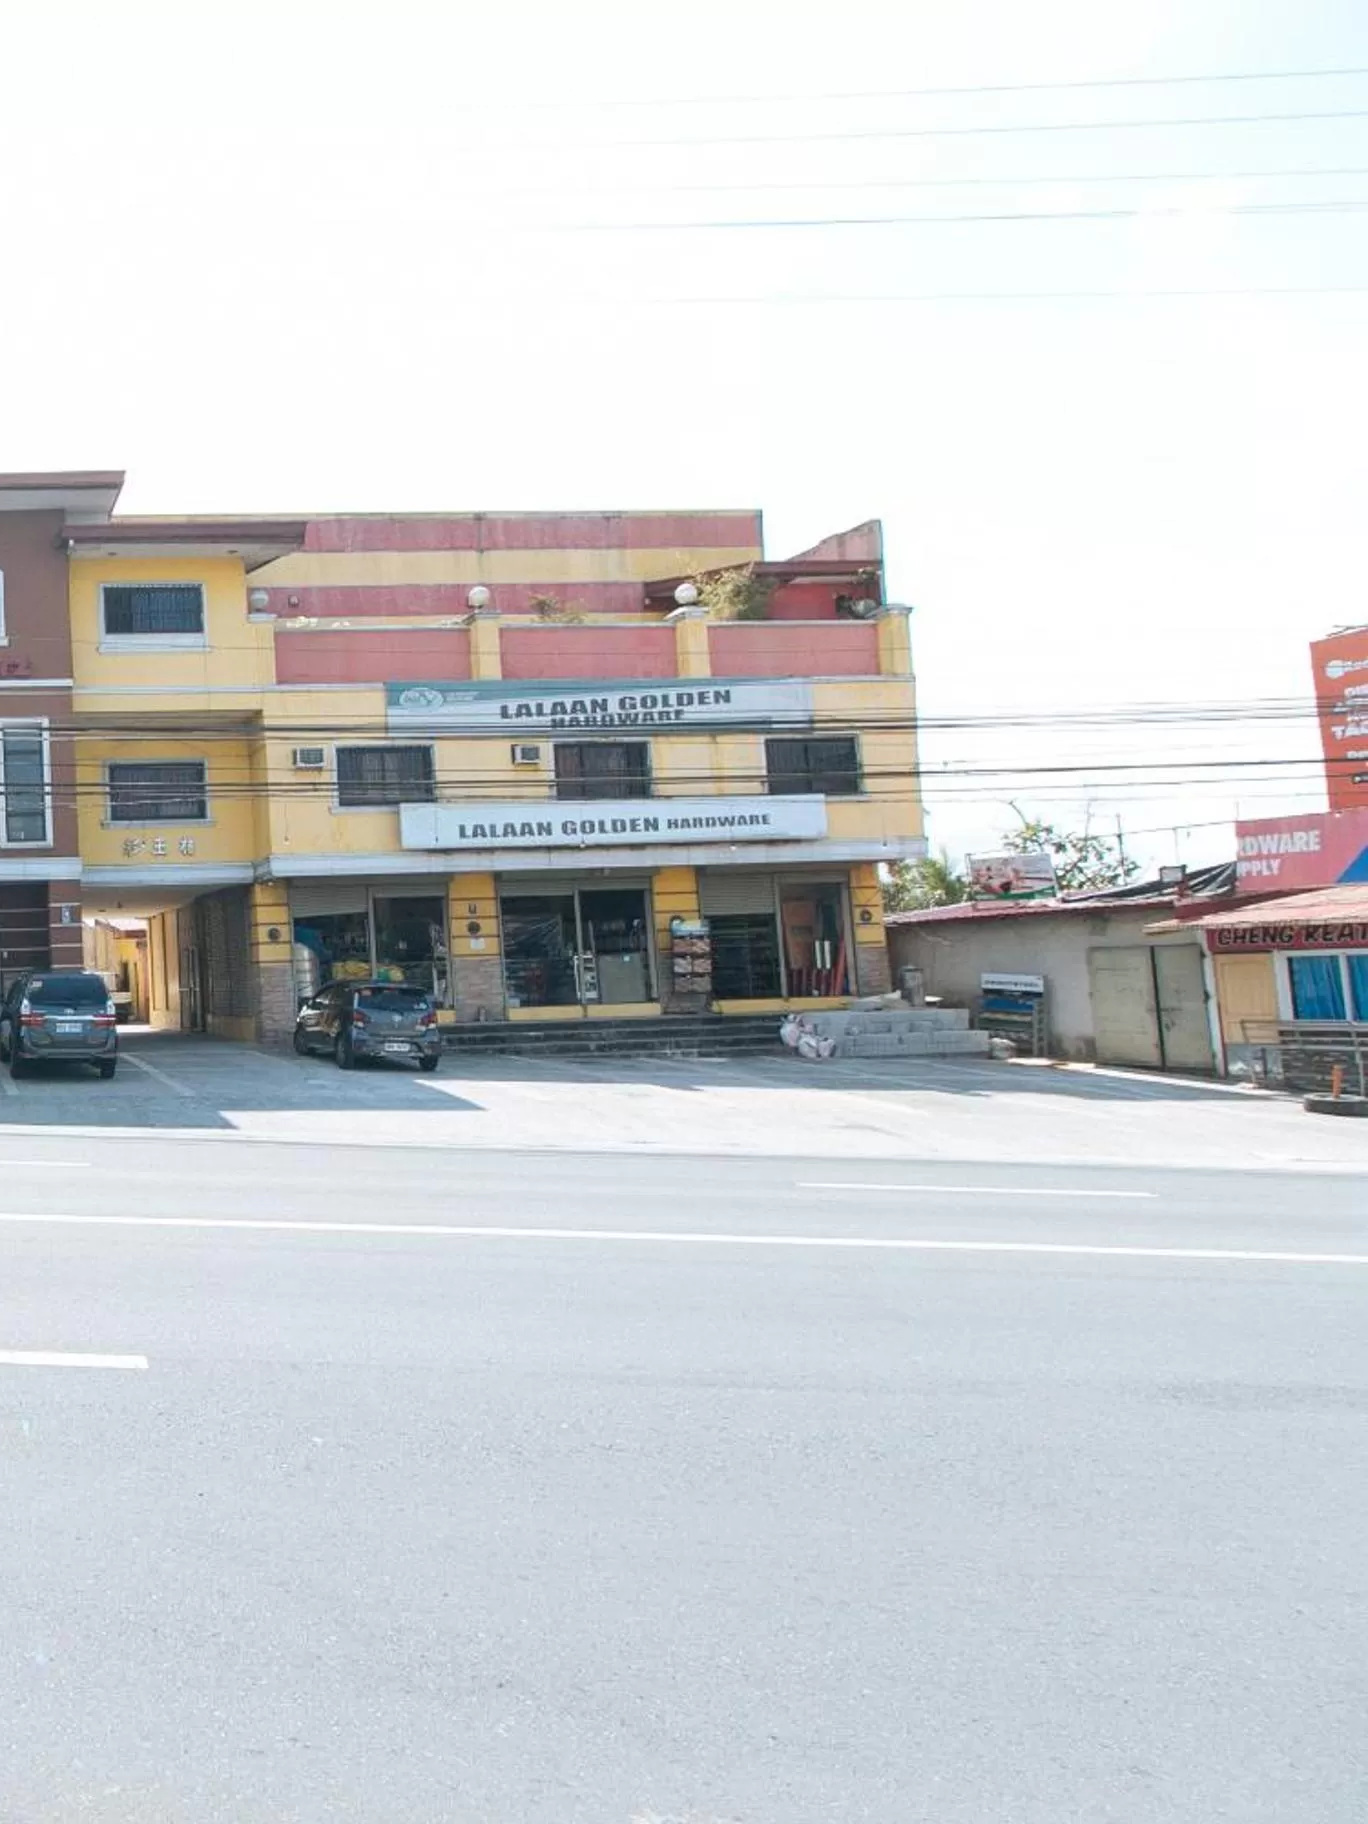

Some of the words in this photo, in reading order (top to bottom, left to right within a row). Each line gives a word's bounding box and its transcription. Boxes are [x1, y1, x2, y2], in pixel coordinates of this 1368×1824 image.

[500, 698, 608, 719] LALAAN
[618, 689, 731, 710] GOLDEN
[550, 709, 684, 729] HARDWARE
[458, 821, 553, 839] LALAAN
[561, 817, 660, 836] GOLDEN
[666, 813, 770, 831] HARDWARE
